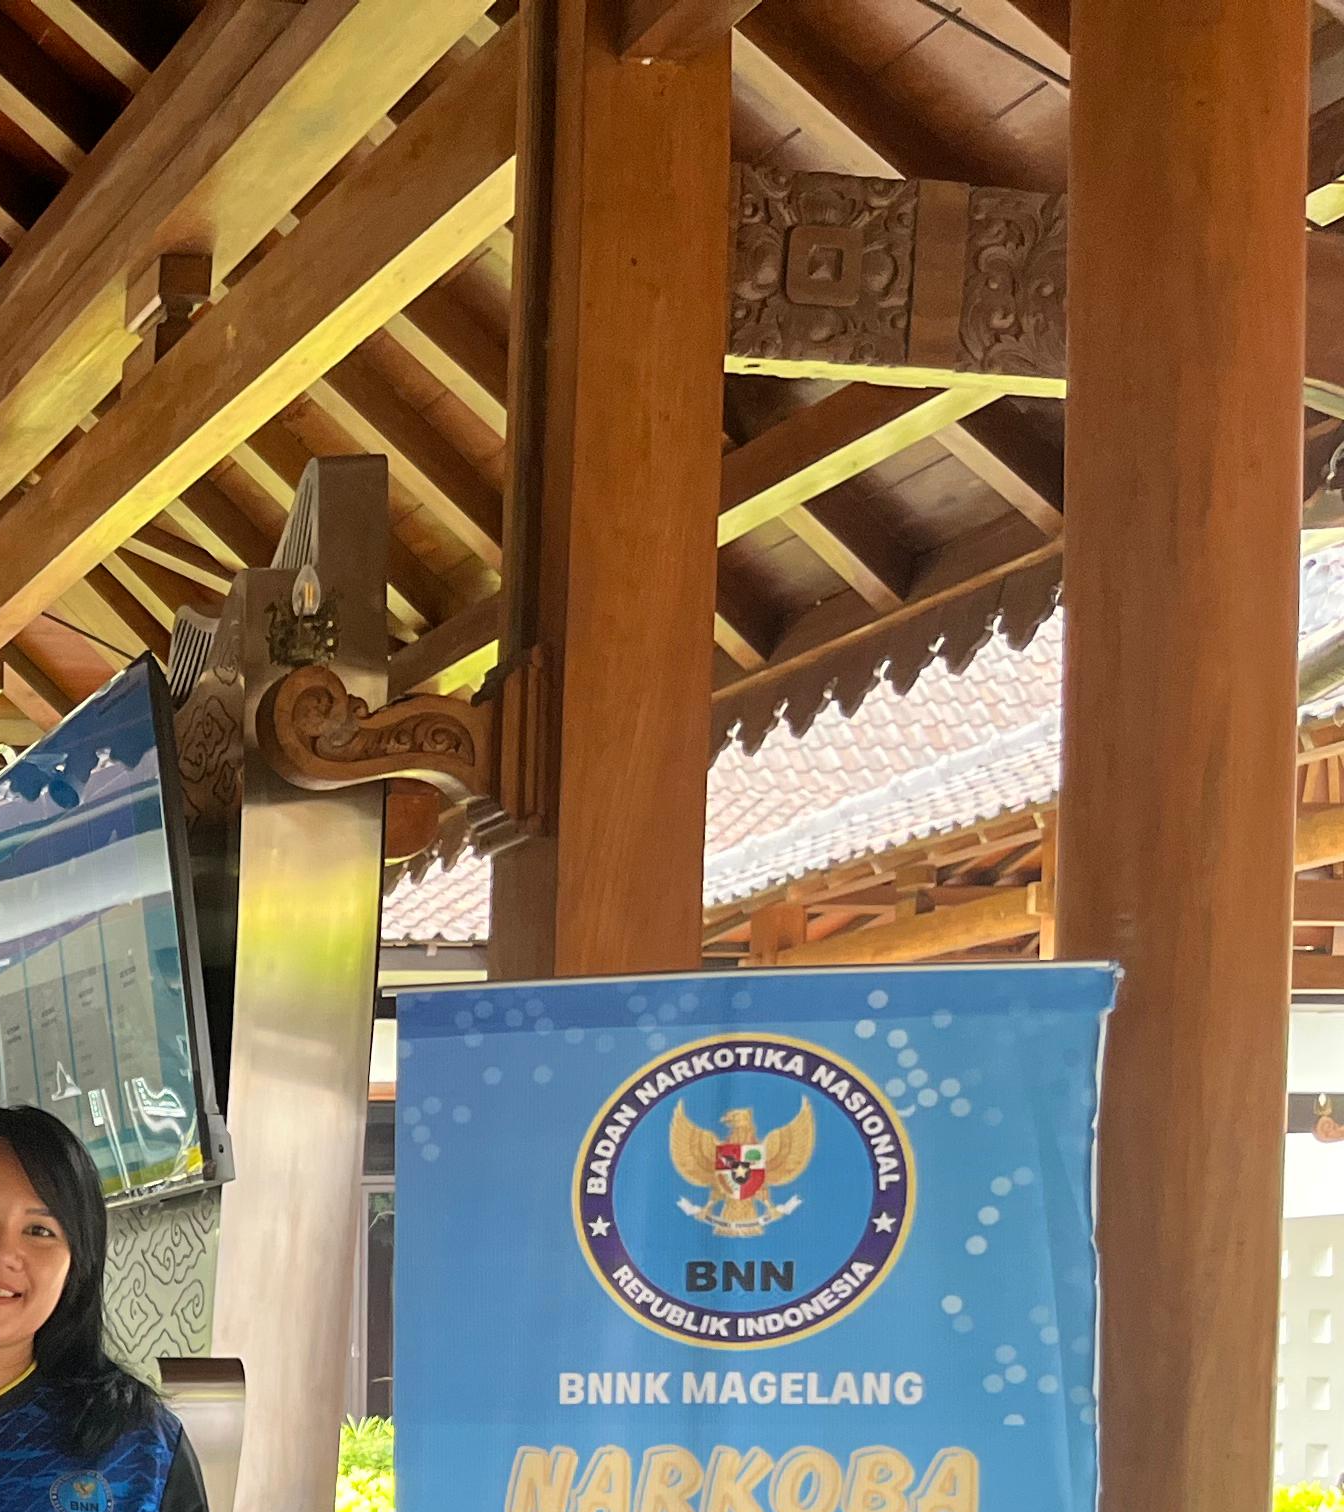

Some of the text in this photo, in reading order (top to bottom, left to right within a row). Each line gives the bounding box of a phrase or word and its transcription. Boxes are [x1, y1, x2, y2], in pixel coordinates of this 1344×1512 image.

[586, 1047, 909, 1195] BADAN NARKOTIKA NASIONAL
[686, 1260, 795, 1294] BNN
[612, 1260, 875, 1338] REPUBLIK INDONESIA
[559, 1371, 924, 1405] BNNK MAGELANG
[70, 1501, 99, 1512] BNN
